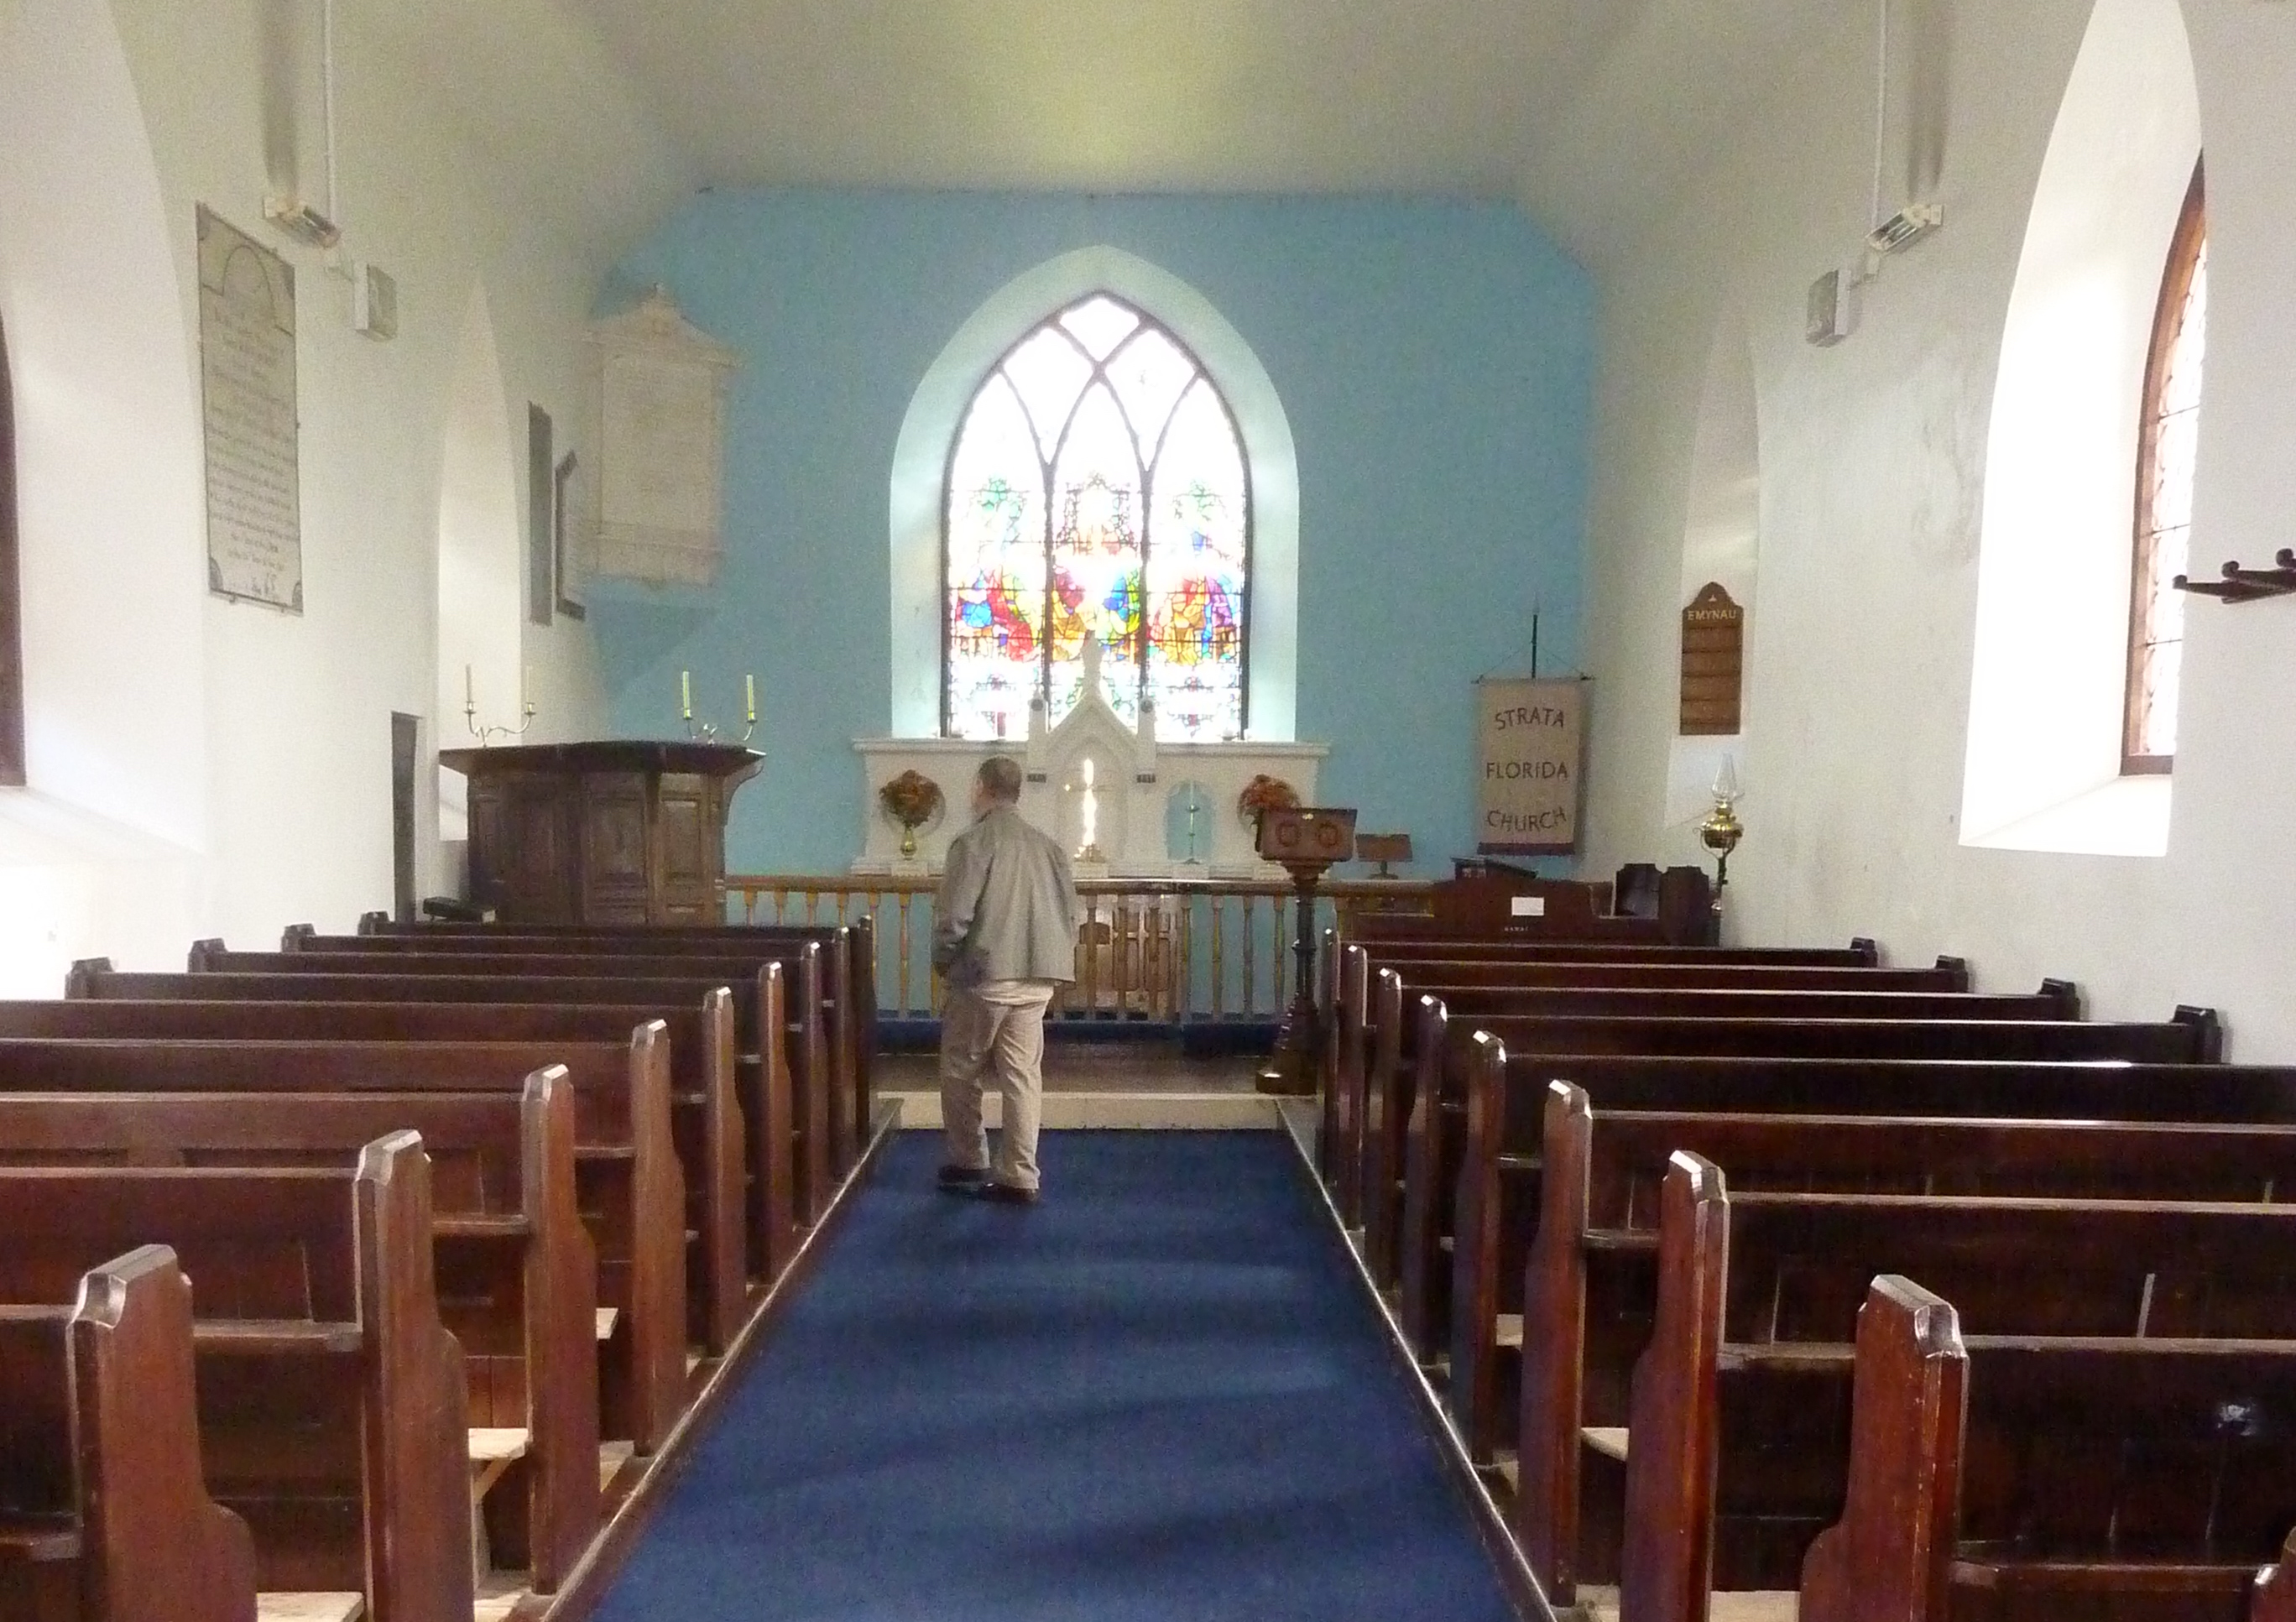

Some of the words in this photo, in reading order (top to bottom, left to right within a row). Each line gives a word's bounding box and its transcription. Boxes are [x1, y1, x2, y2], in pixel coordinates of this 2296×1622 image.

[1688, 609, 1736, 621] EMYNAU
[1495, 707, 1565, 731] STRATA
[1485, 761, 1568, 780] FLORIDA
[1485, 806, 1568, 832] CHURCH
